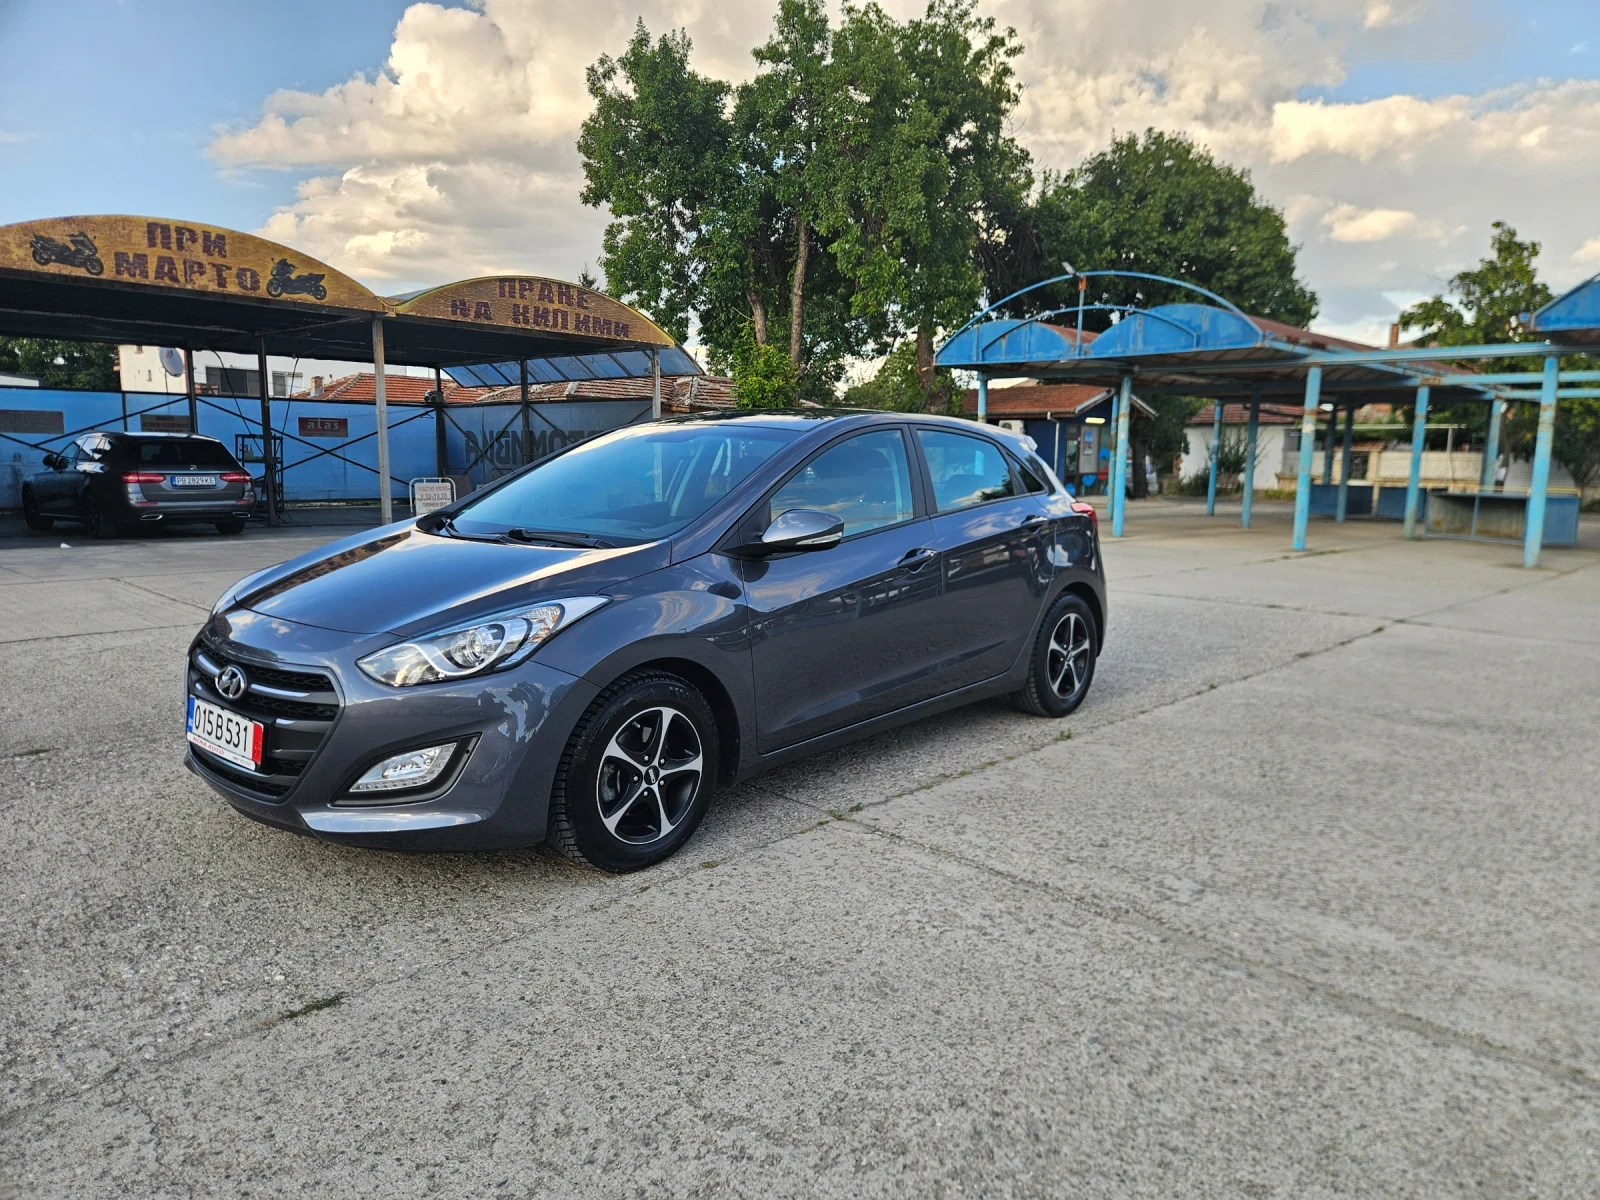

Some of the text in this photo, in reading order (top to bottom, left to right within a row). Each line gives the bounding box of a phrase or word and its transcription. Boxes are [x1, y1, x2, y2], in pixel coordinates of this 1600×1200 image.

[146, 222, 227, 258] ПРИ
[113, 251, 260, 292] МАРТО
[498, 277, 590, 310] ПРАНЕ
[450, 299, 631, 338] НА КИЛИМИ
[208, 744, 225, 756] AUTO
